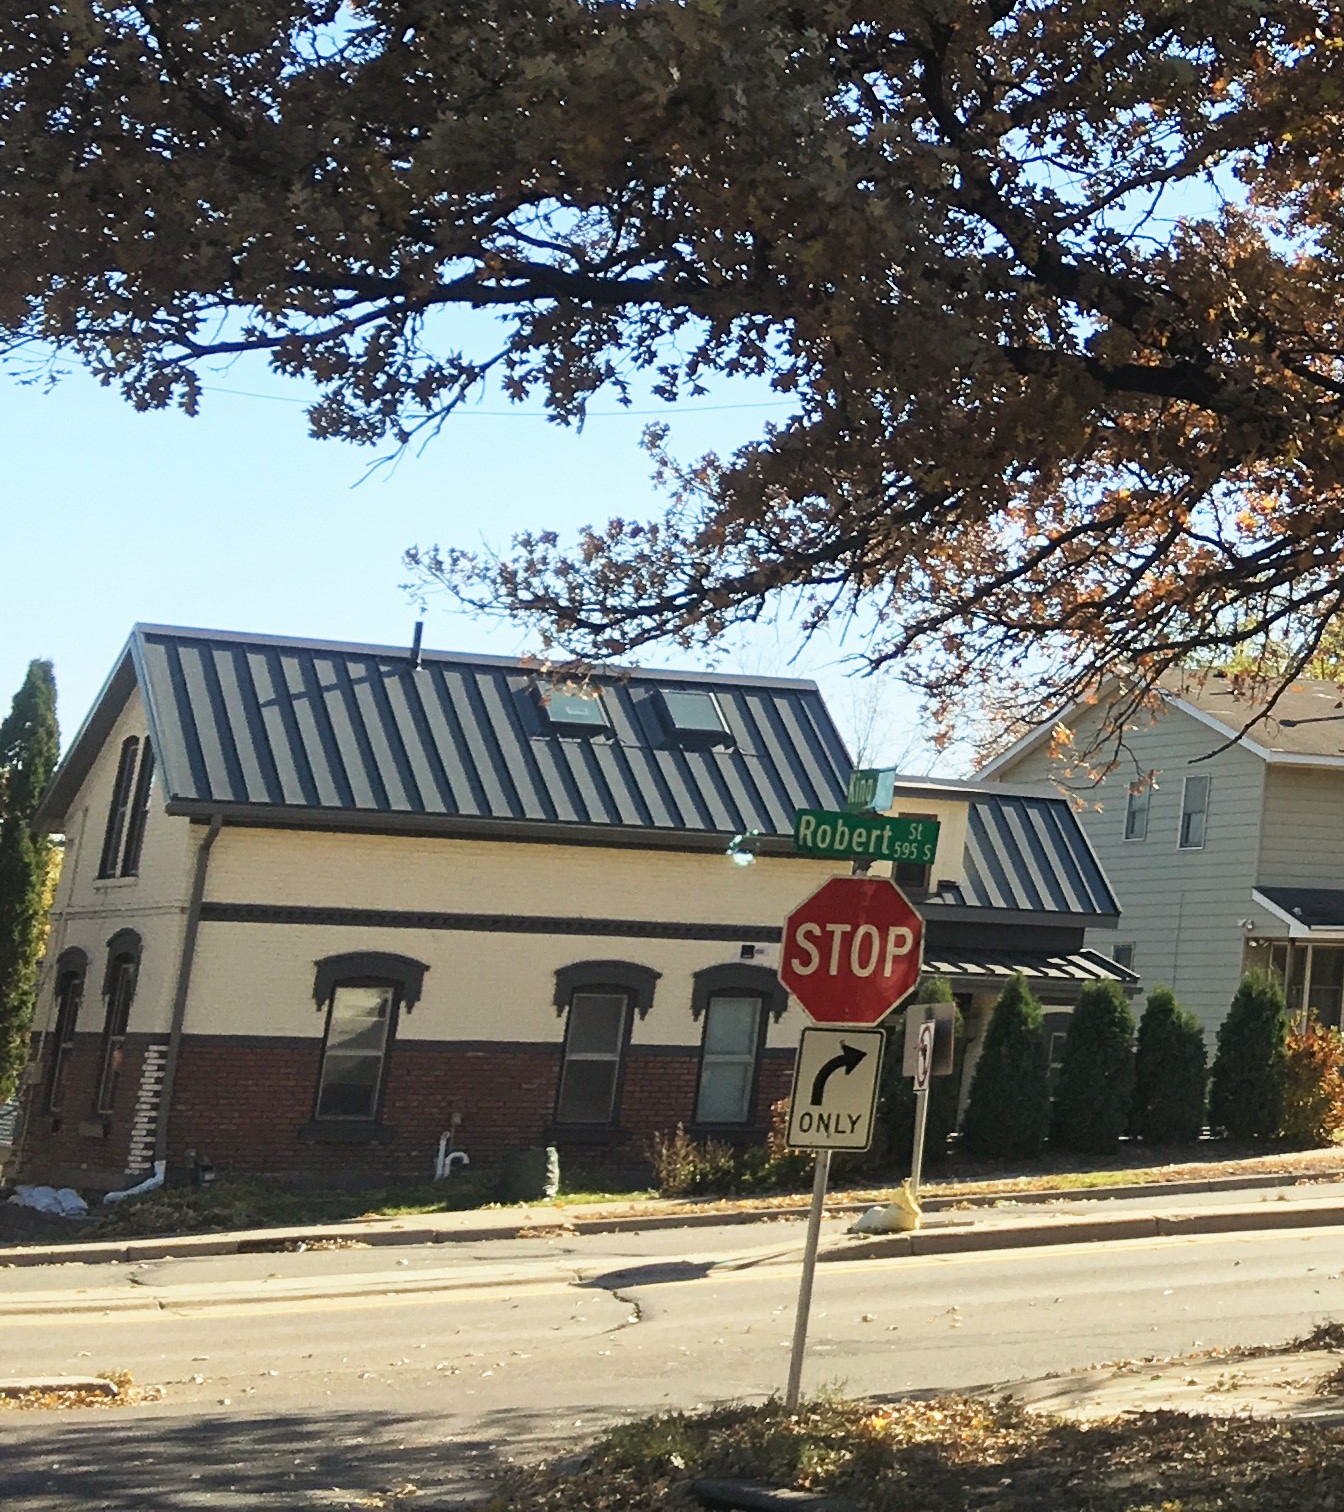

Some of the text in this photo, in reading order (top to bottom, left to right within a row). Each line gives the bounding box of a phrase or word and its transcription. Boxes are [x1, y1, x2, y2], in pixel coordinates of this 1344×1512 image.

[848, 772, 874, 809] King
[799, 815, 923, 854] Robert St
[893, 841, 932, 860] 595 S
[791, 922, 914, 977] STOP
[799, 1112, 862, 1134] ONLY
